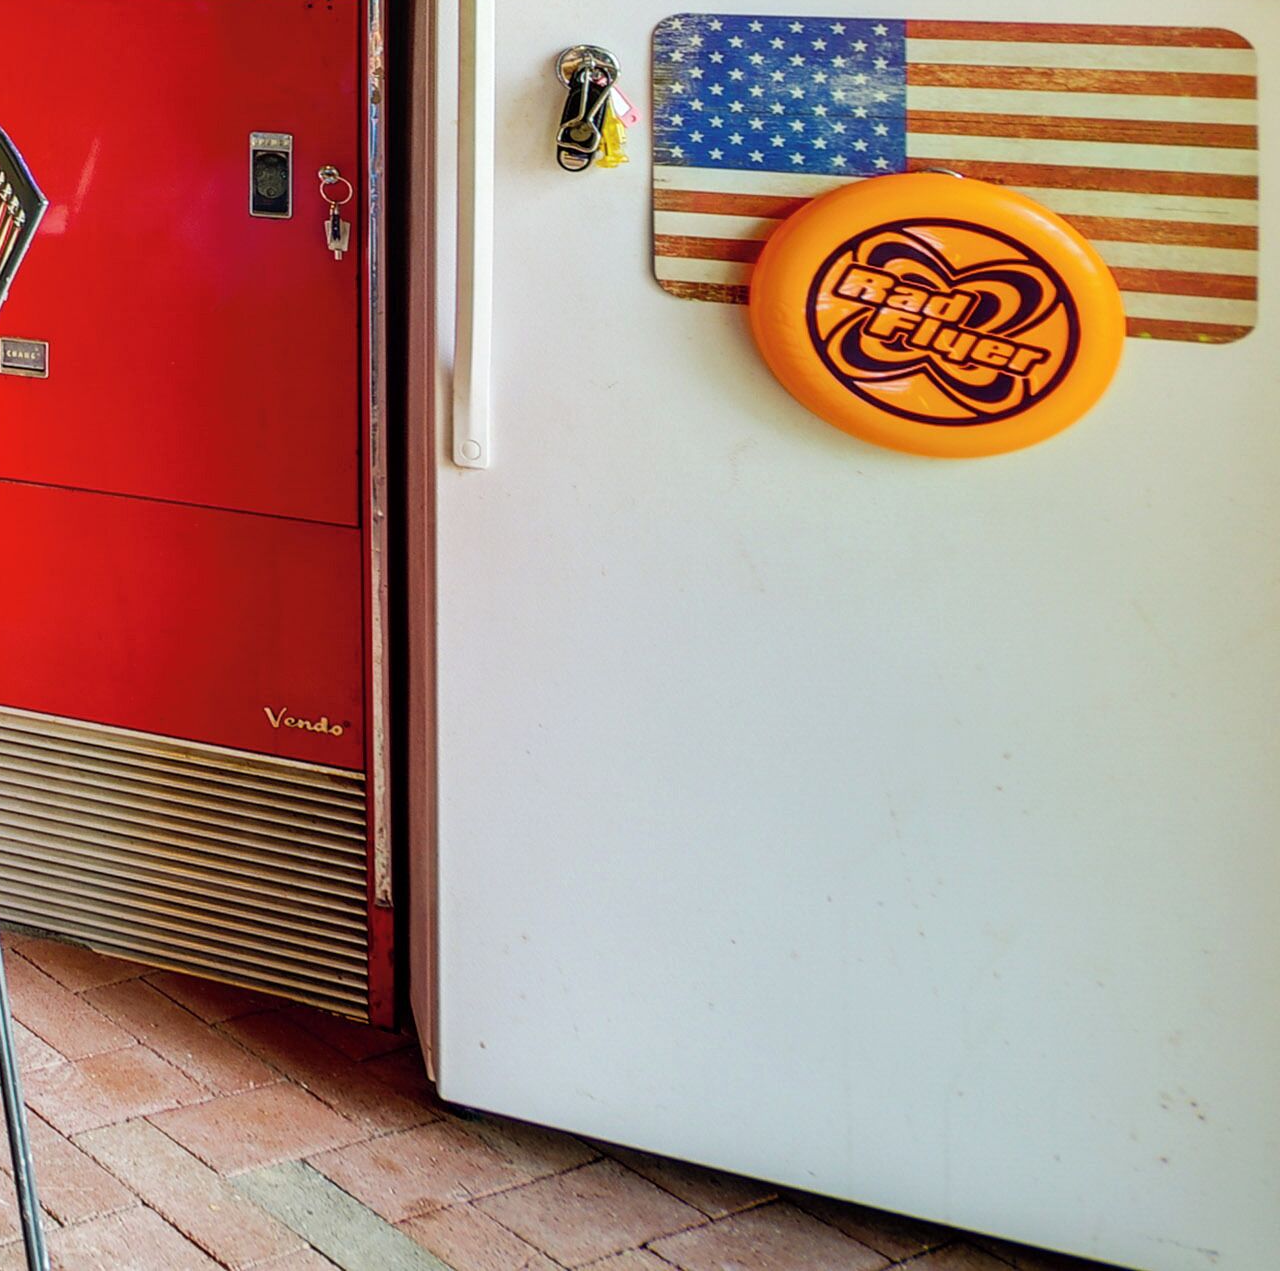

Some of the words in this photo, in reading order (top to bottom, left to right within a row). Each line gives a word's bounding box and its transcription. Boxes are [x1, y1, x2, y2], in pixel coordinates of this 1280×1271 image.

[838, 267, 974, 323] Rad
[868, 308, 1041, 373] Flyer
[262, 705, 345, 738] Vendo
